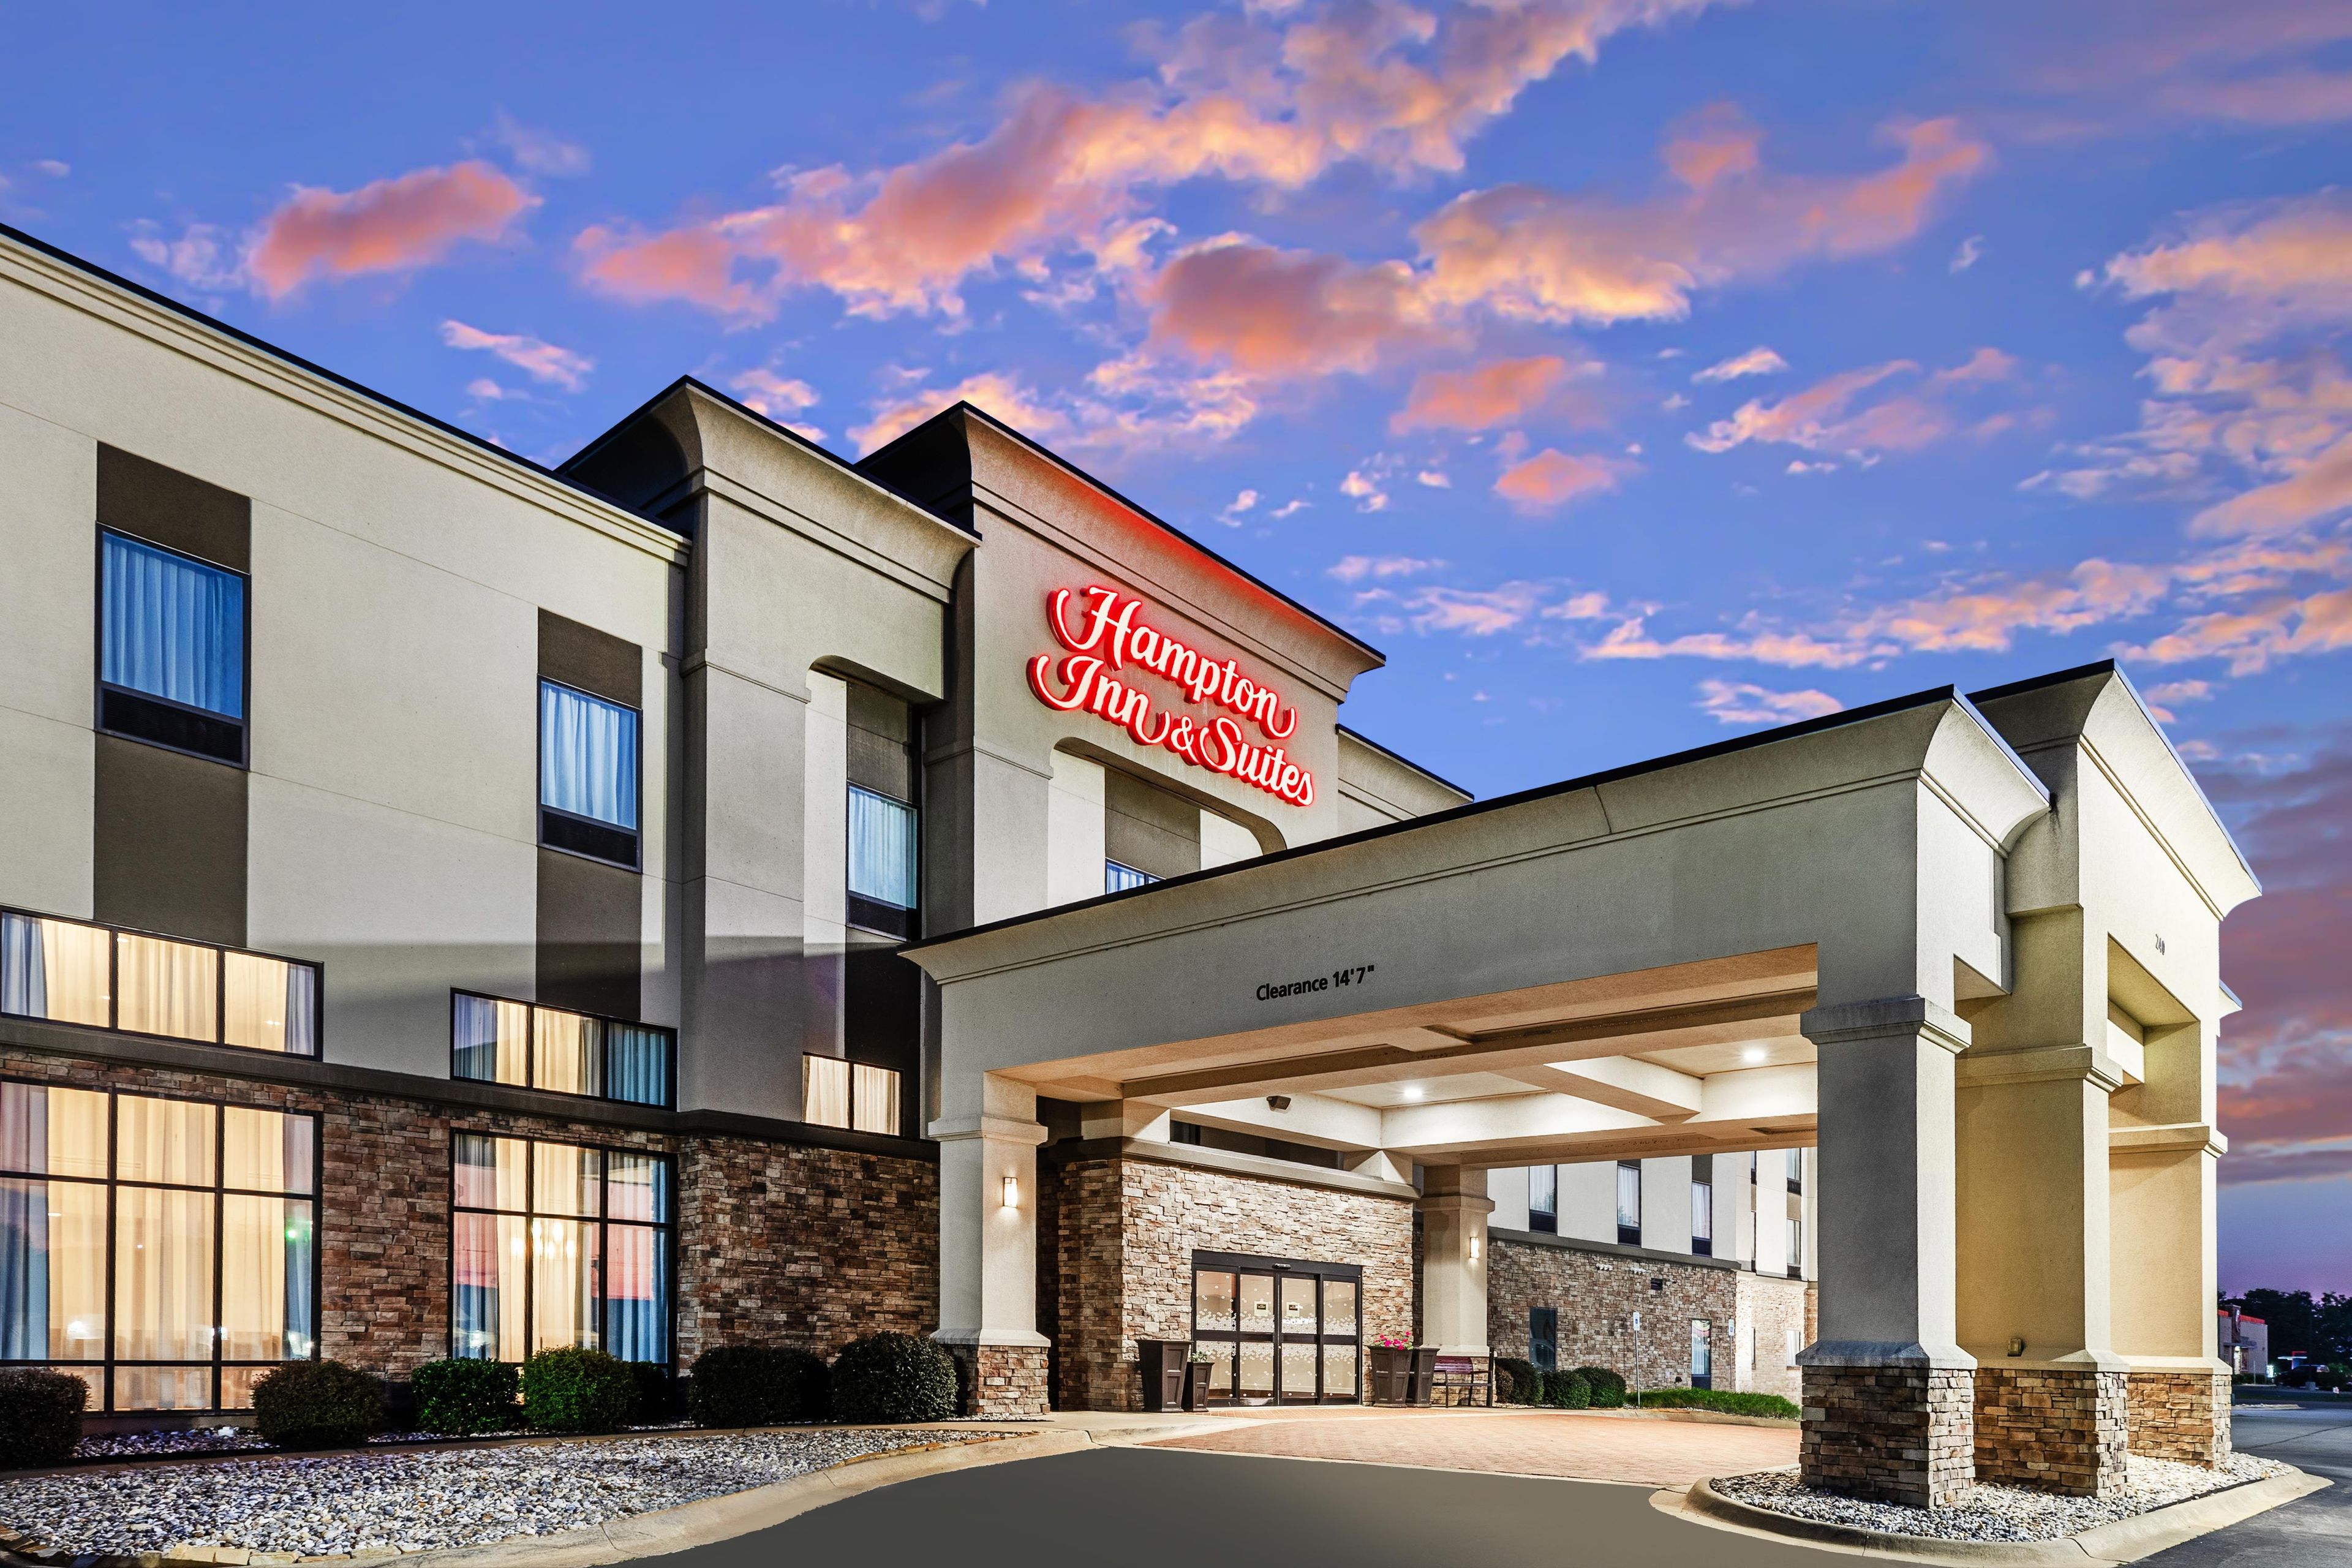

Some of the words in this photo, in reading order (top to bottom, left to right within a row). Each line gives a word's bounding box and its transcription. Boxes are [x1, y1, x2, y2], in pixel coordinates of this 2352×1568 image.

[1028, 655, 1170, 745] Inn
[1167, 715, 1200, 765] &
[1199, 717, 1314, 807] Suites
[1047, 586, 1295, 739] Hampton
[1256, 978, 1329, 1001] Clearance
[1332, 964, 1375, 988] 14'7"
